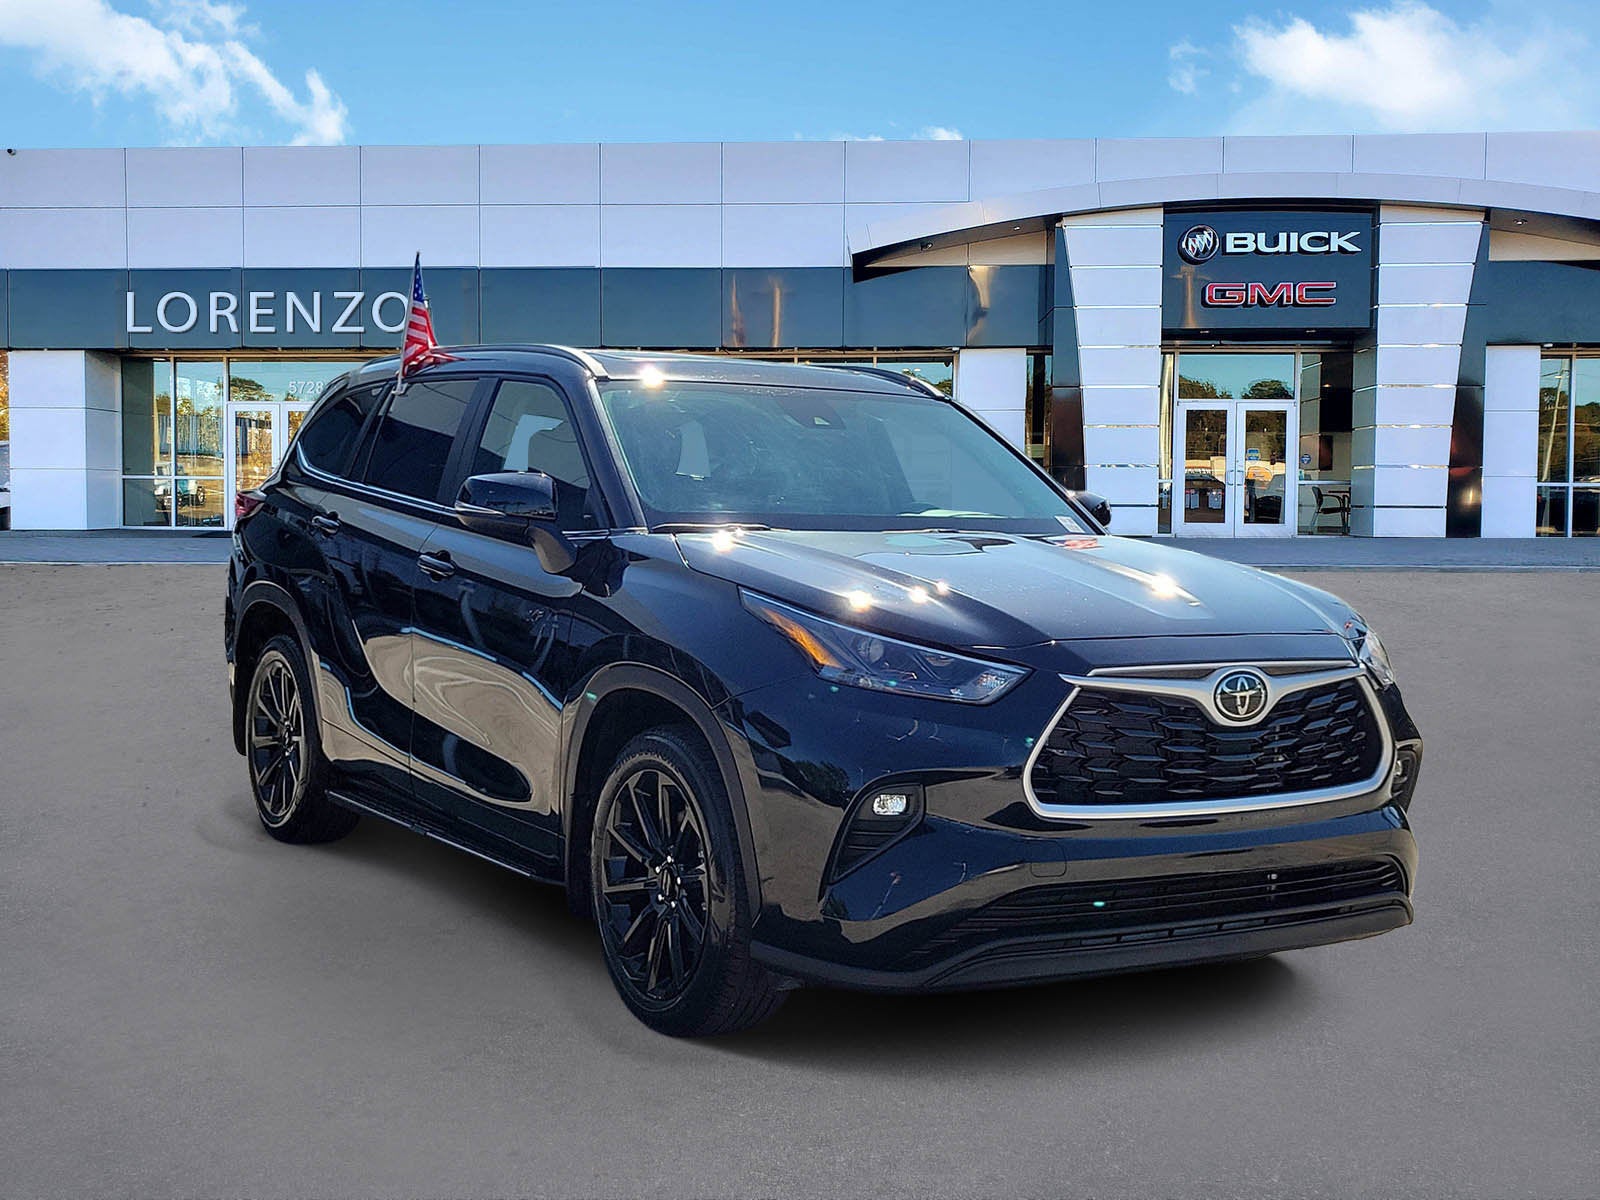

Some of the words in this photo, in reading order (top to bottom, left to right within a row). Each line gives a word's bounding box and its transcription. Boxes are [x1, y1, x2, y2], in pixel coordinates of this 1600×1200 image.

[1226, 231, 1362, 253] BUICK
[1206, 281, 1337, 305] GMC
[126, 291, 409, 333] LORENZO
[288, 380, 324, 394] 5728
